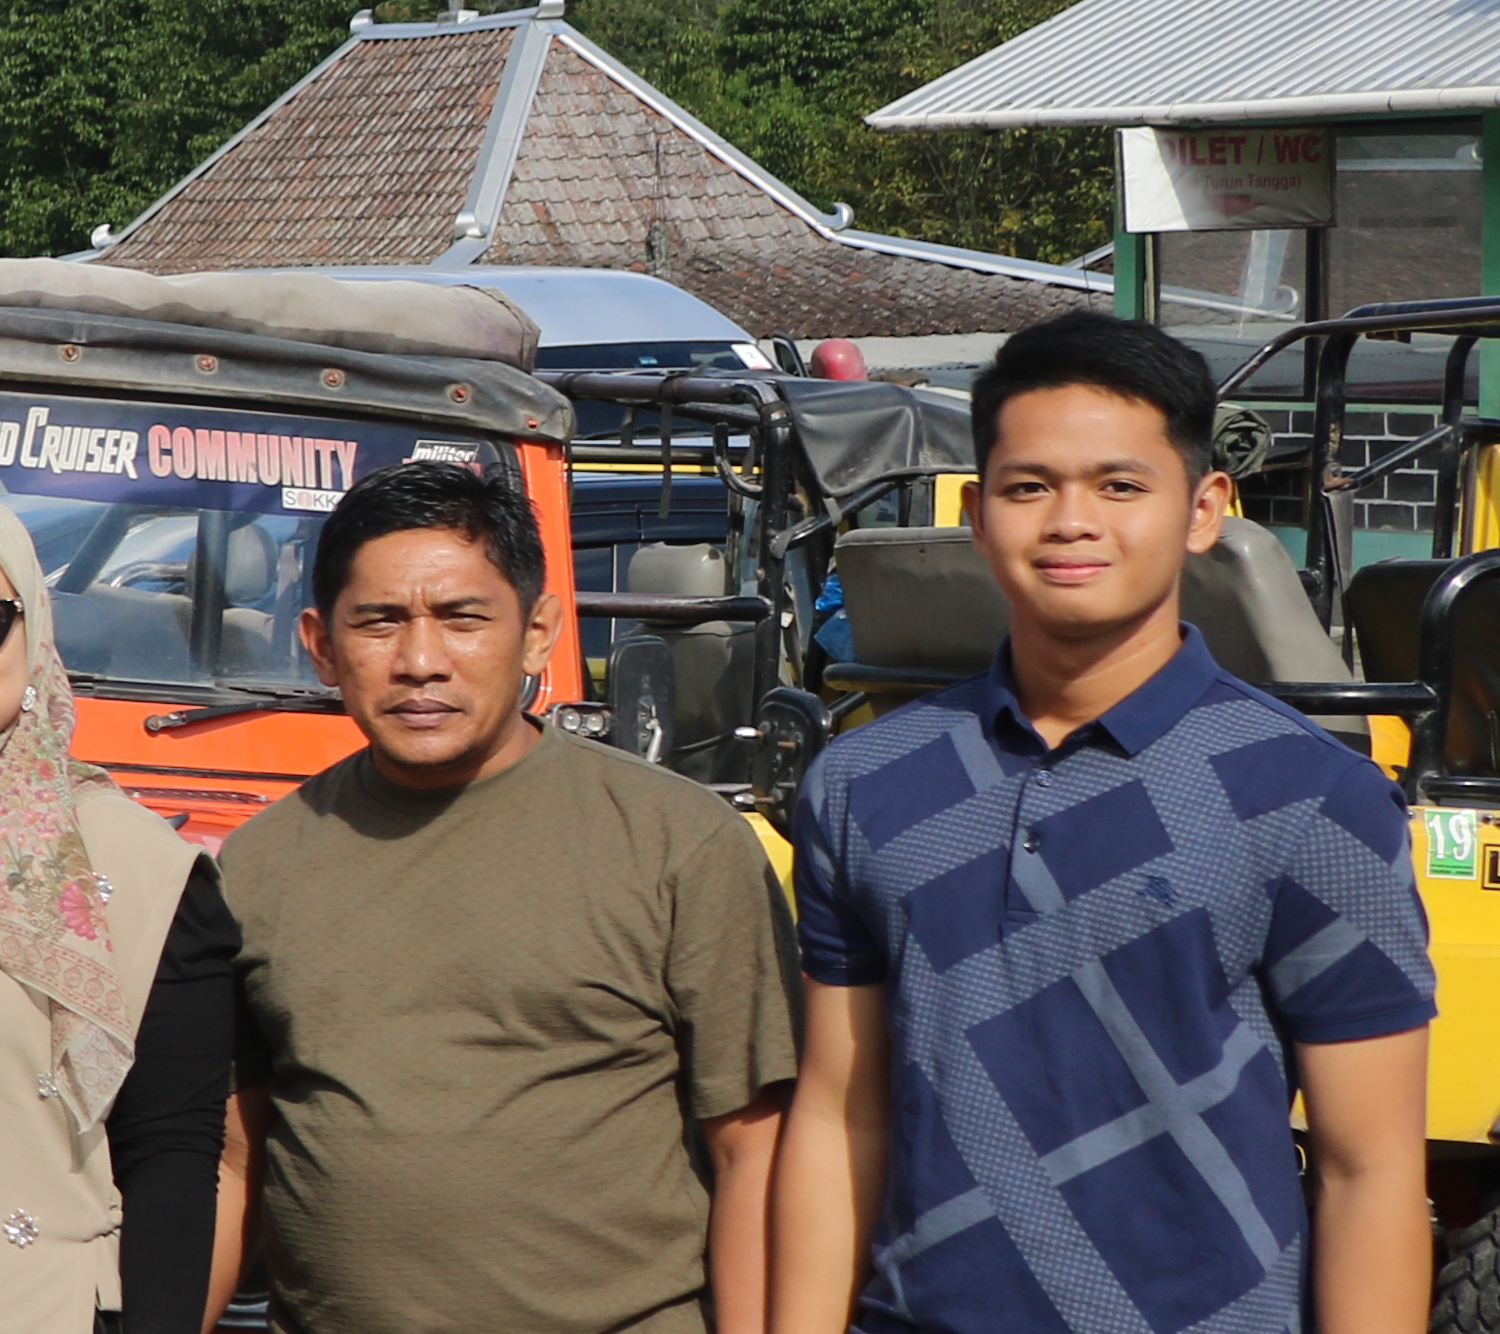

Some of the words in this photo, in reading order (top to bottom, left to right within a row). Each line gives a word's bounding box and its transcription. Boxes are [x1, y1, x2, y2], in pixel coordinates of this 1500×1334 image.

[1162, 136, 1247, 166] ILET
[1273, 134, 1322, 164] WC
[147, 424, 358, 490] COMMUNITY
[1428, 814, 1472, 861] 19
